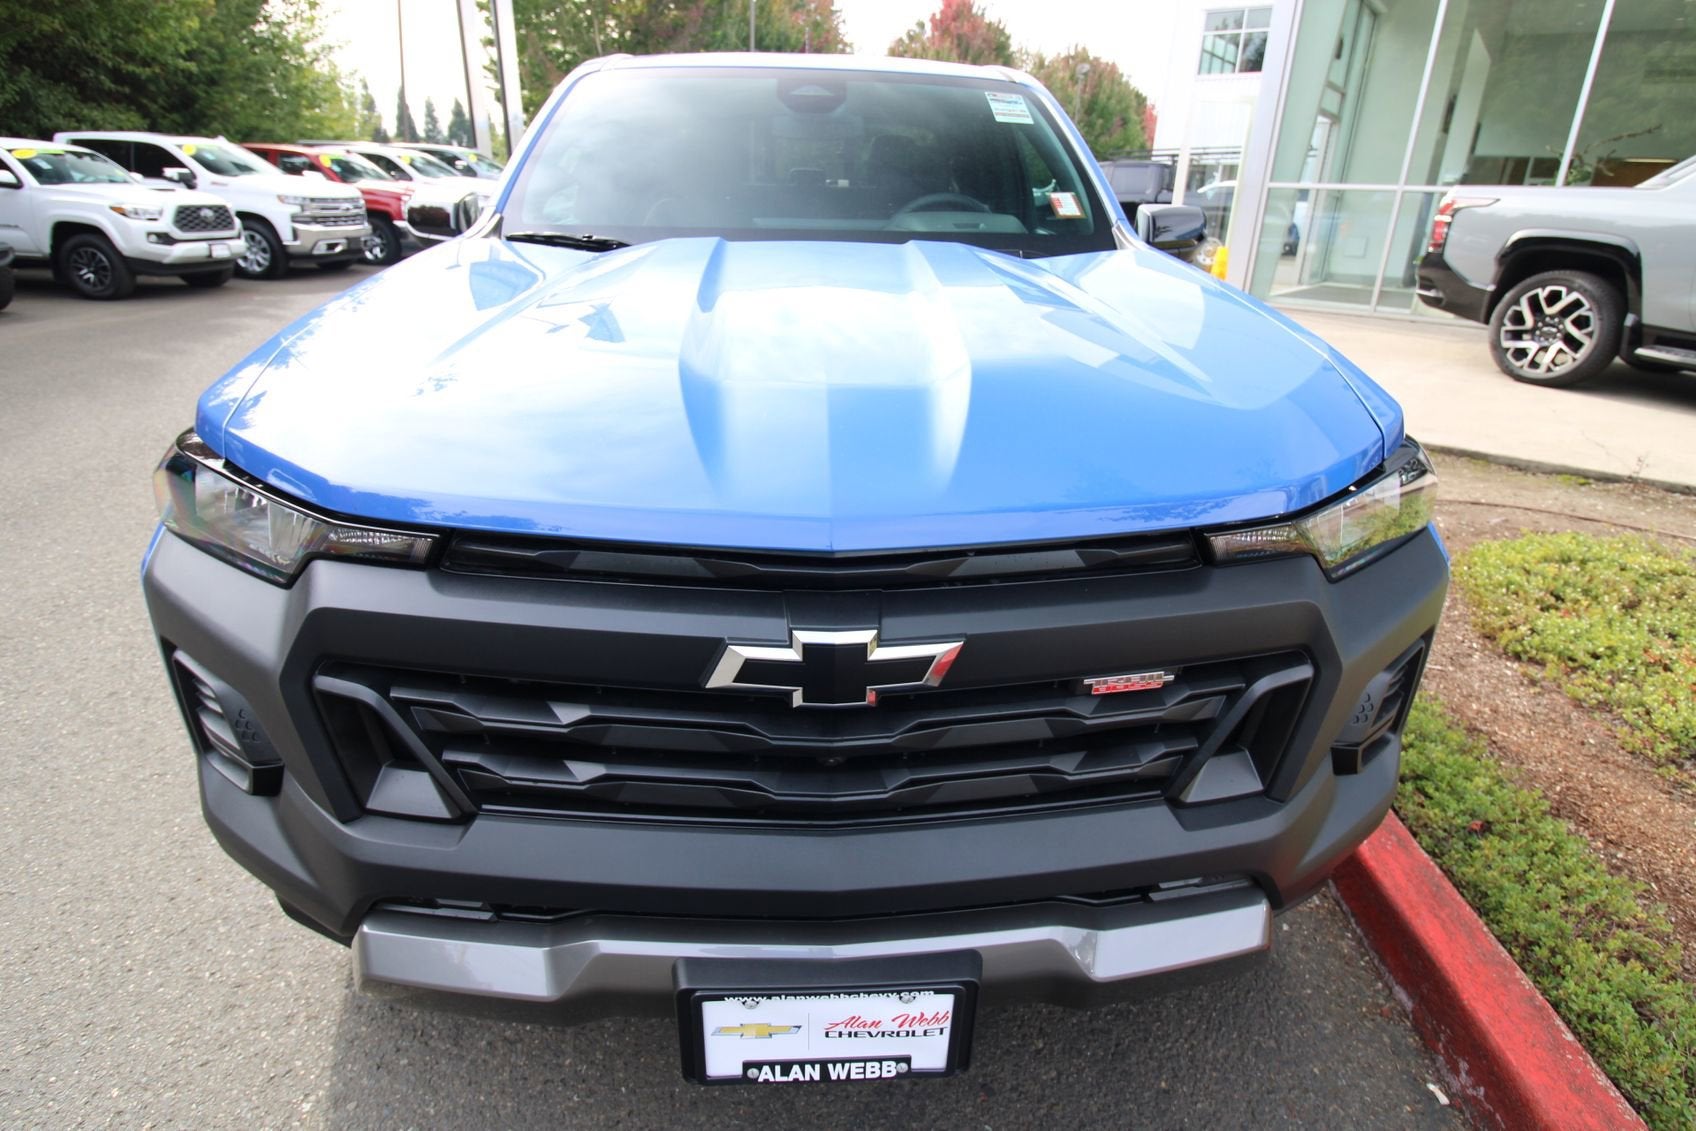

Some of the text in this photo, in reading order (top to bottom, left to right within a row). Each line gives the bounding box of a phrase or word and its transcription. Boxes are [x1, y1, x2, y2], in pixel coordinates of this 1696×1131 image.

[824, 1010, 950, 1030] Alan Webb
[825, 1027, 948, 1039] CHEVROLET
[757, 1060, 898, 1082] ALAN WEBB
